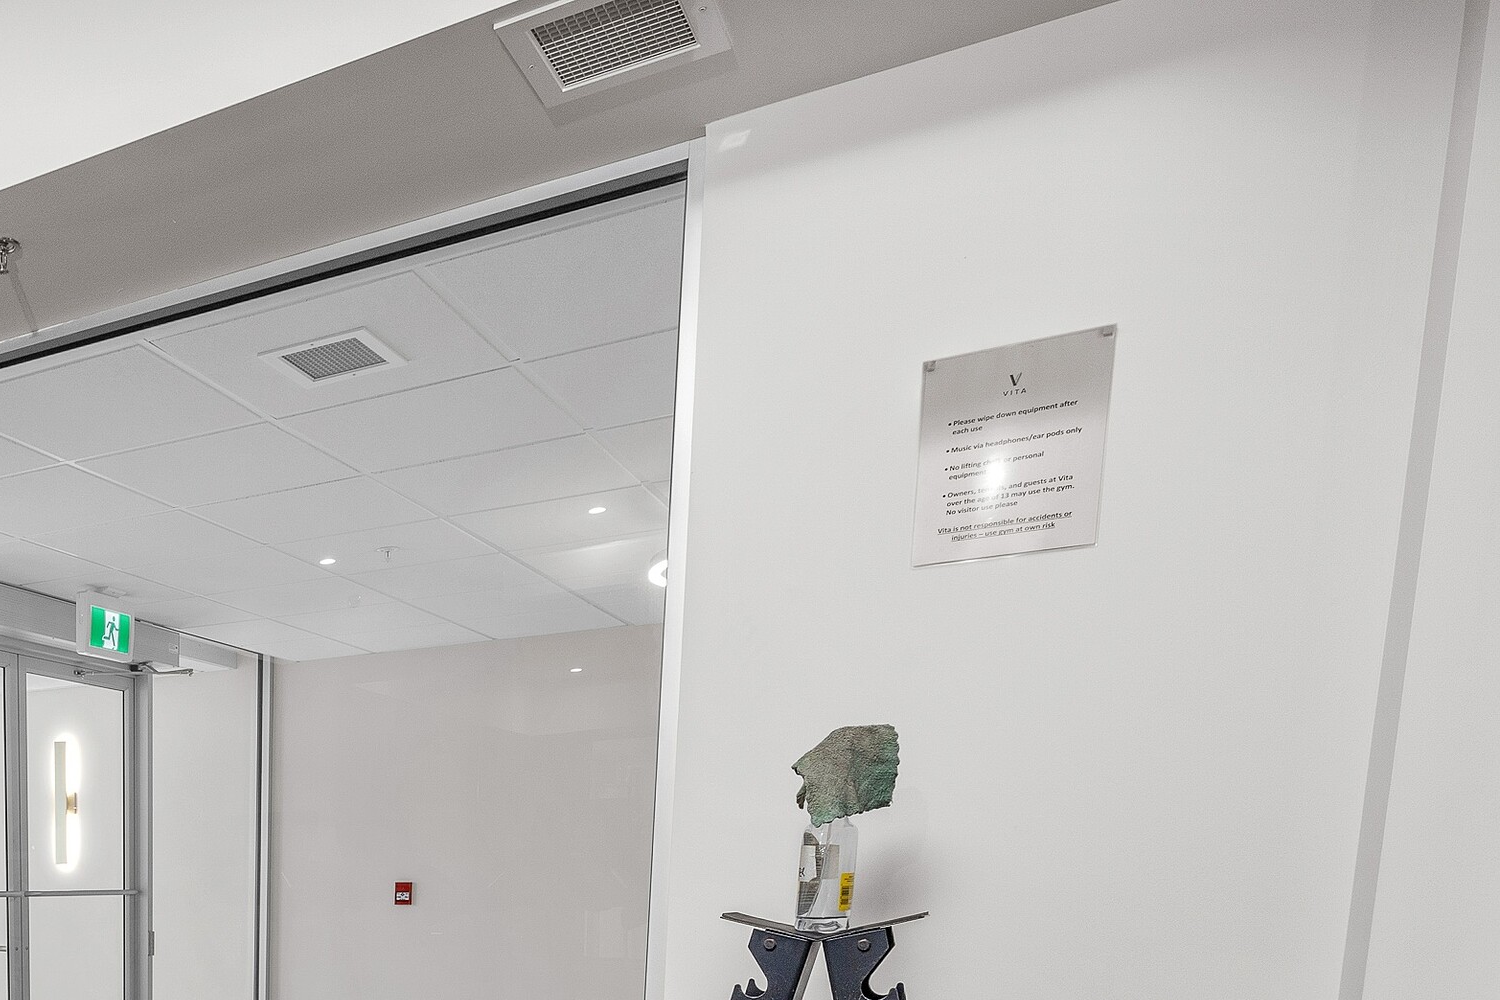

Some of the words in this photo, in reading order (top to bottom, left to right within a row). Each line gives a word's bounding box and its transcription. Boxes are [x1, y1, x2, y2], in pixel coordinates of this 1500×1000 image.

[1010, 372, 1022, 386] V
[1002, 388, 1027, 397] VITA
[953, 418, 976, 427] Please
[996, 411, 1016, 419] down
[1018, 403, 1058, 415] equipment
[1060, 400, 1078, 408] after
[951, 445, 972, 453] Music
[985, 432, 1045, 448] headphones/ear
[1046, 430, 1064, 439] pods
[1066, 426, 1083, 434] only
[961, 461, 982, 470] lifting
[1012, 451, 1044, 462] personal
[947, 490, 976, 498] Owners,
[1024, 478, 1047, 488] guests
[994, 501, 1018, 510] please
[973, 518, 1014, 529] responsible
[1028, 512, 1062, 522] accidents
[951, 533, 977, 541] injuries
[998, 528, 1014, 536] gym
